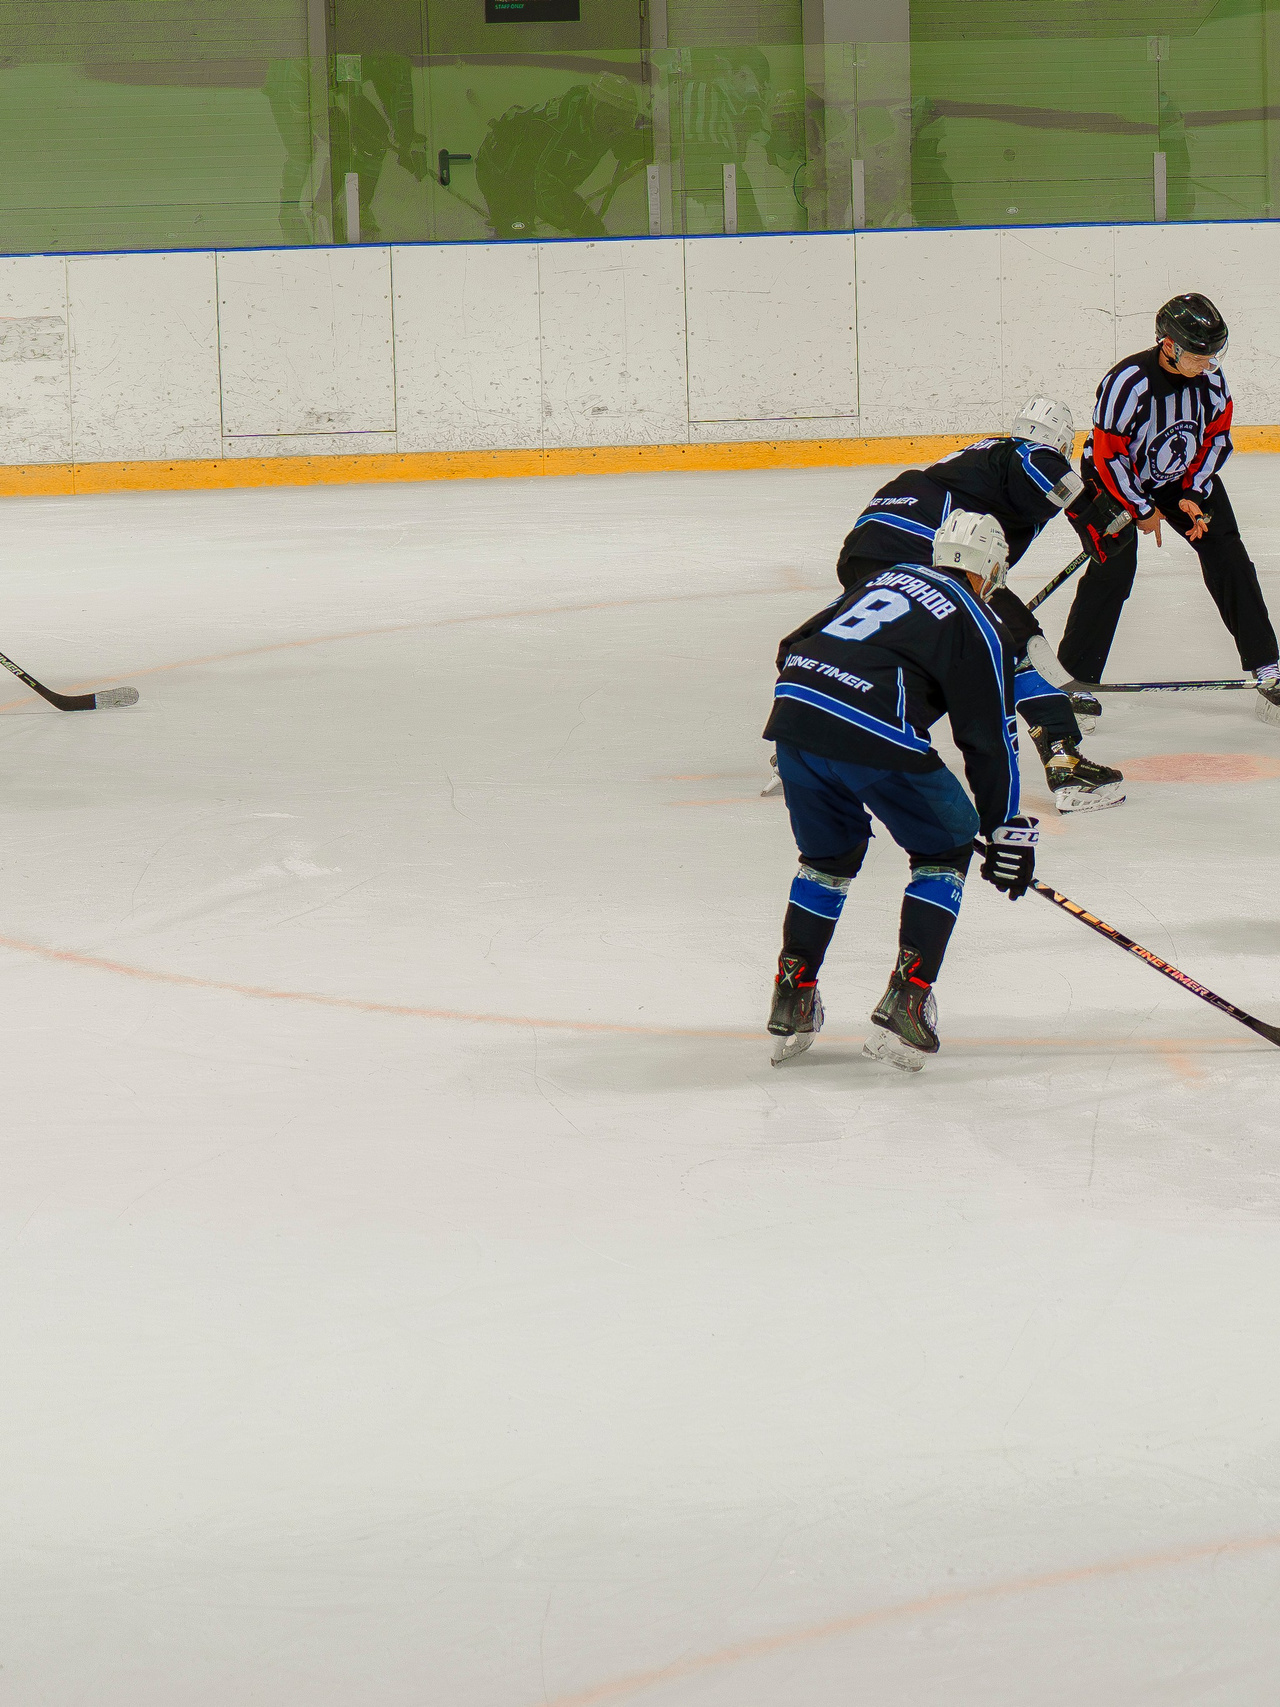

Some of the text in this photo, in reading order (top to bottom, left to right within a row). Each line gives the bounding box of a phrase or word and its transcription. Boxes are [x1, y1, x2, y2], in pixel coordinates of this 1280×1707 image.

[1030, 425, 1036, 434] 7
[880, 496, 919, 506] TIMER
[954, 552, 961, 563] 8
[865, 571, 957, 620] ЗЫРЯНОВ
[820, 587, 912, 641] 8
[787, 655, 874, 693] ONE TIMER
[1003, 829, 1040, 843] CC
[1131, 944, 1211, 997] ONE TIMER
